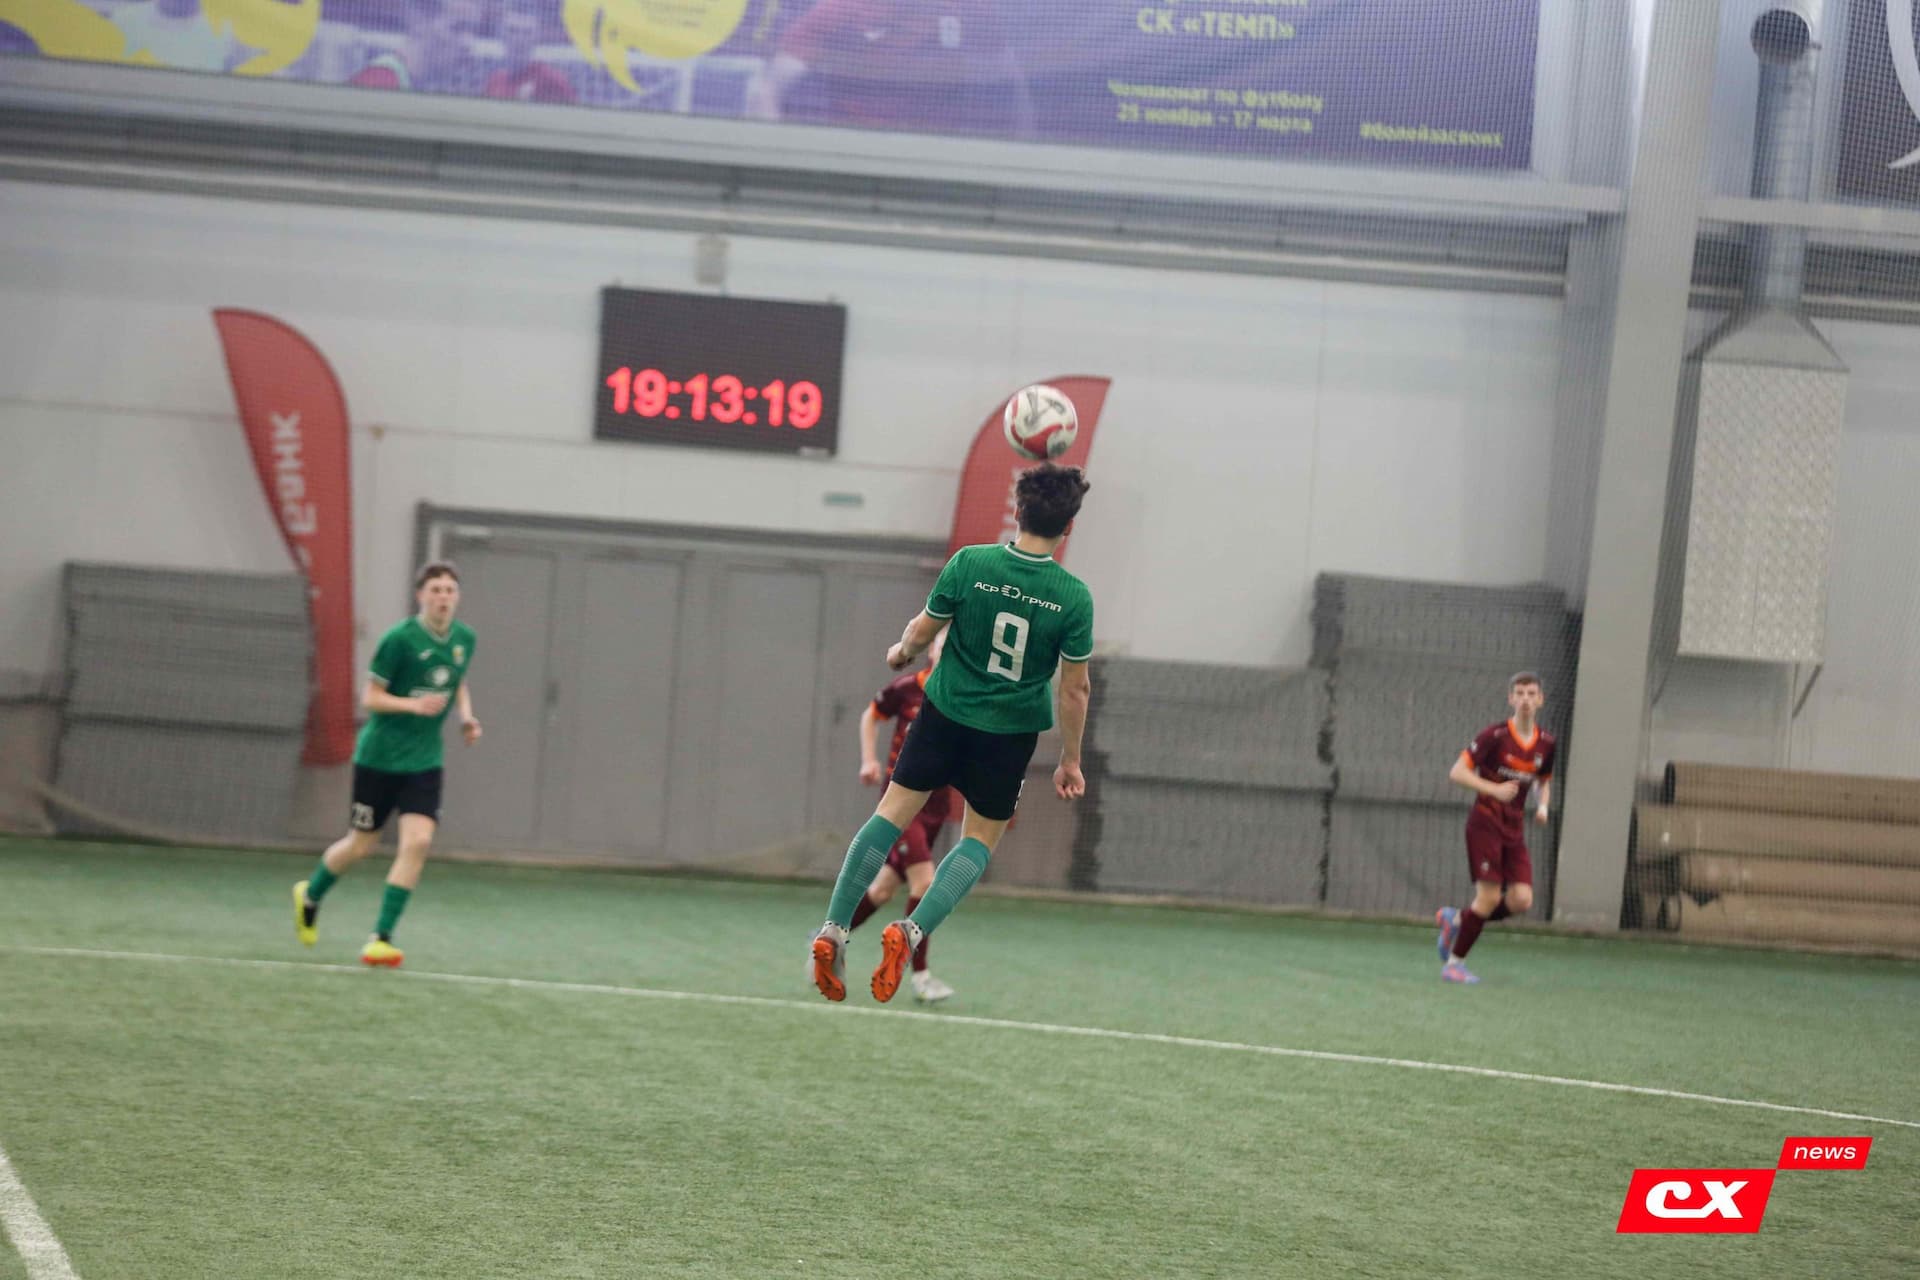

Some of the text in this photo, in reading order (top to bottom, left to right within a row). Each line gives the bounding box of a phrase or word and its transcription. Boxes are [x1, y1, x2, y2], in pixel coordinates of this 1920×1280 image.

[1137, 8, 1296, 40] СК «ТЕМП»
[606, 366, 822, 429] 19:13:19
[1021, 595, 1063, 613] ГРУПП
[986, 612, 1030, 683] 9
